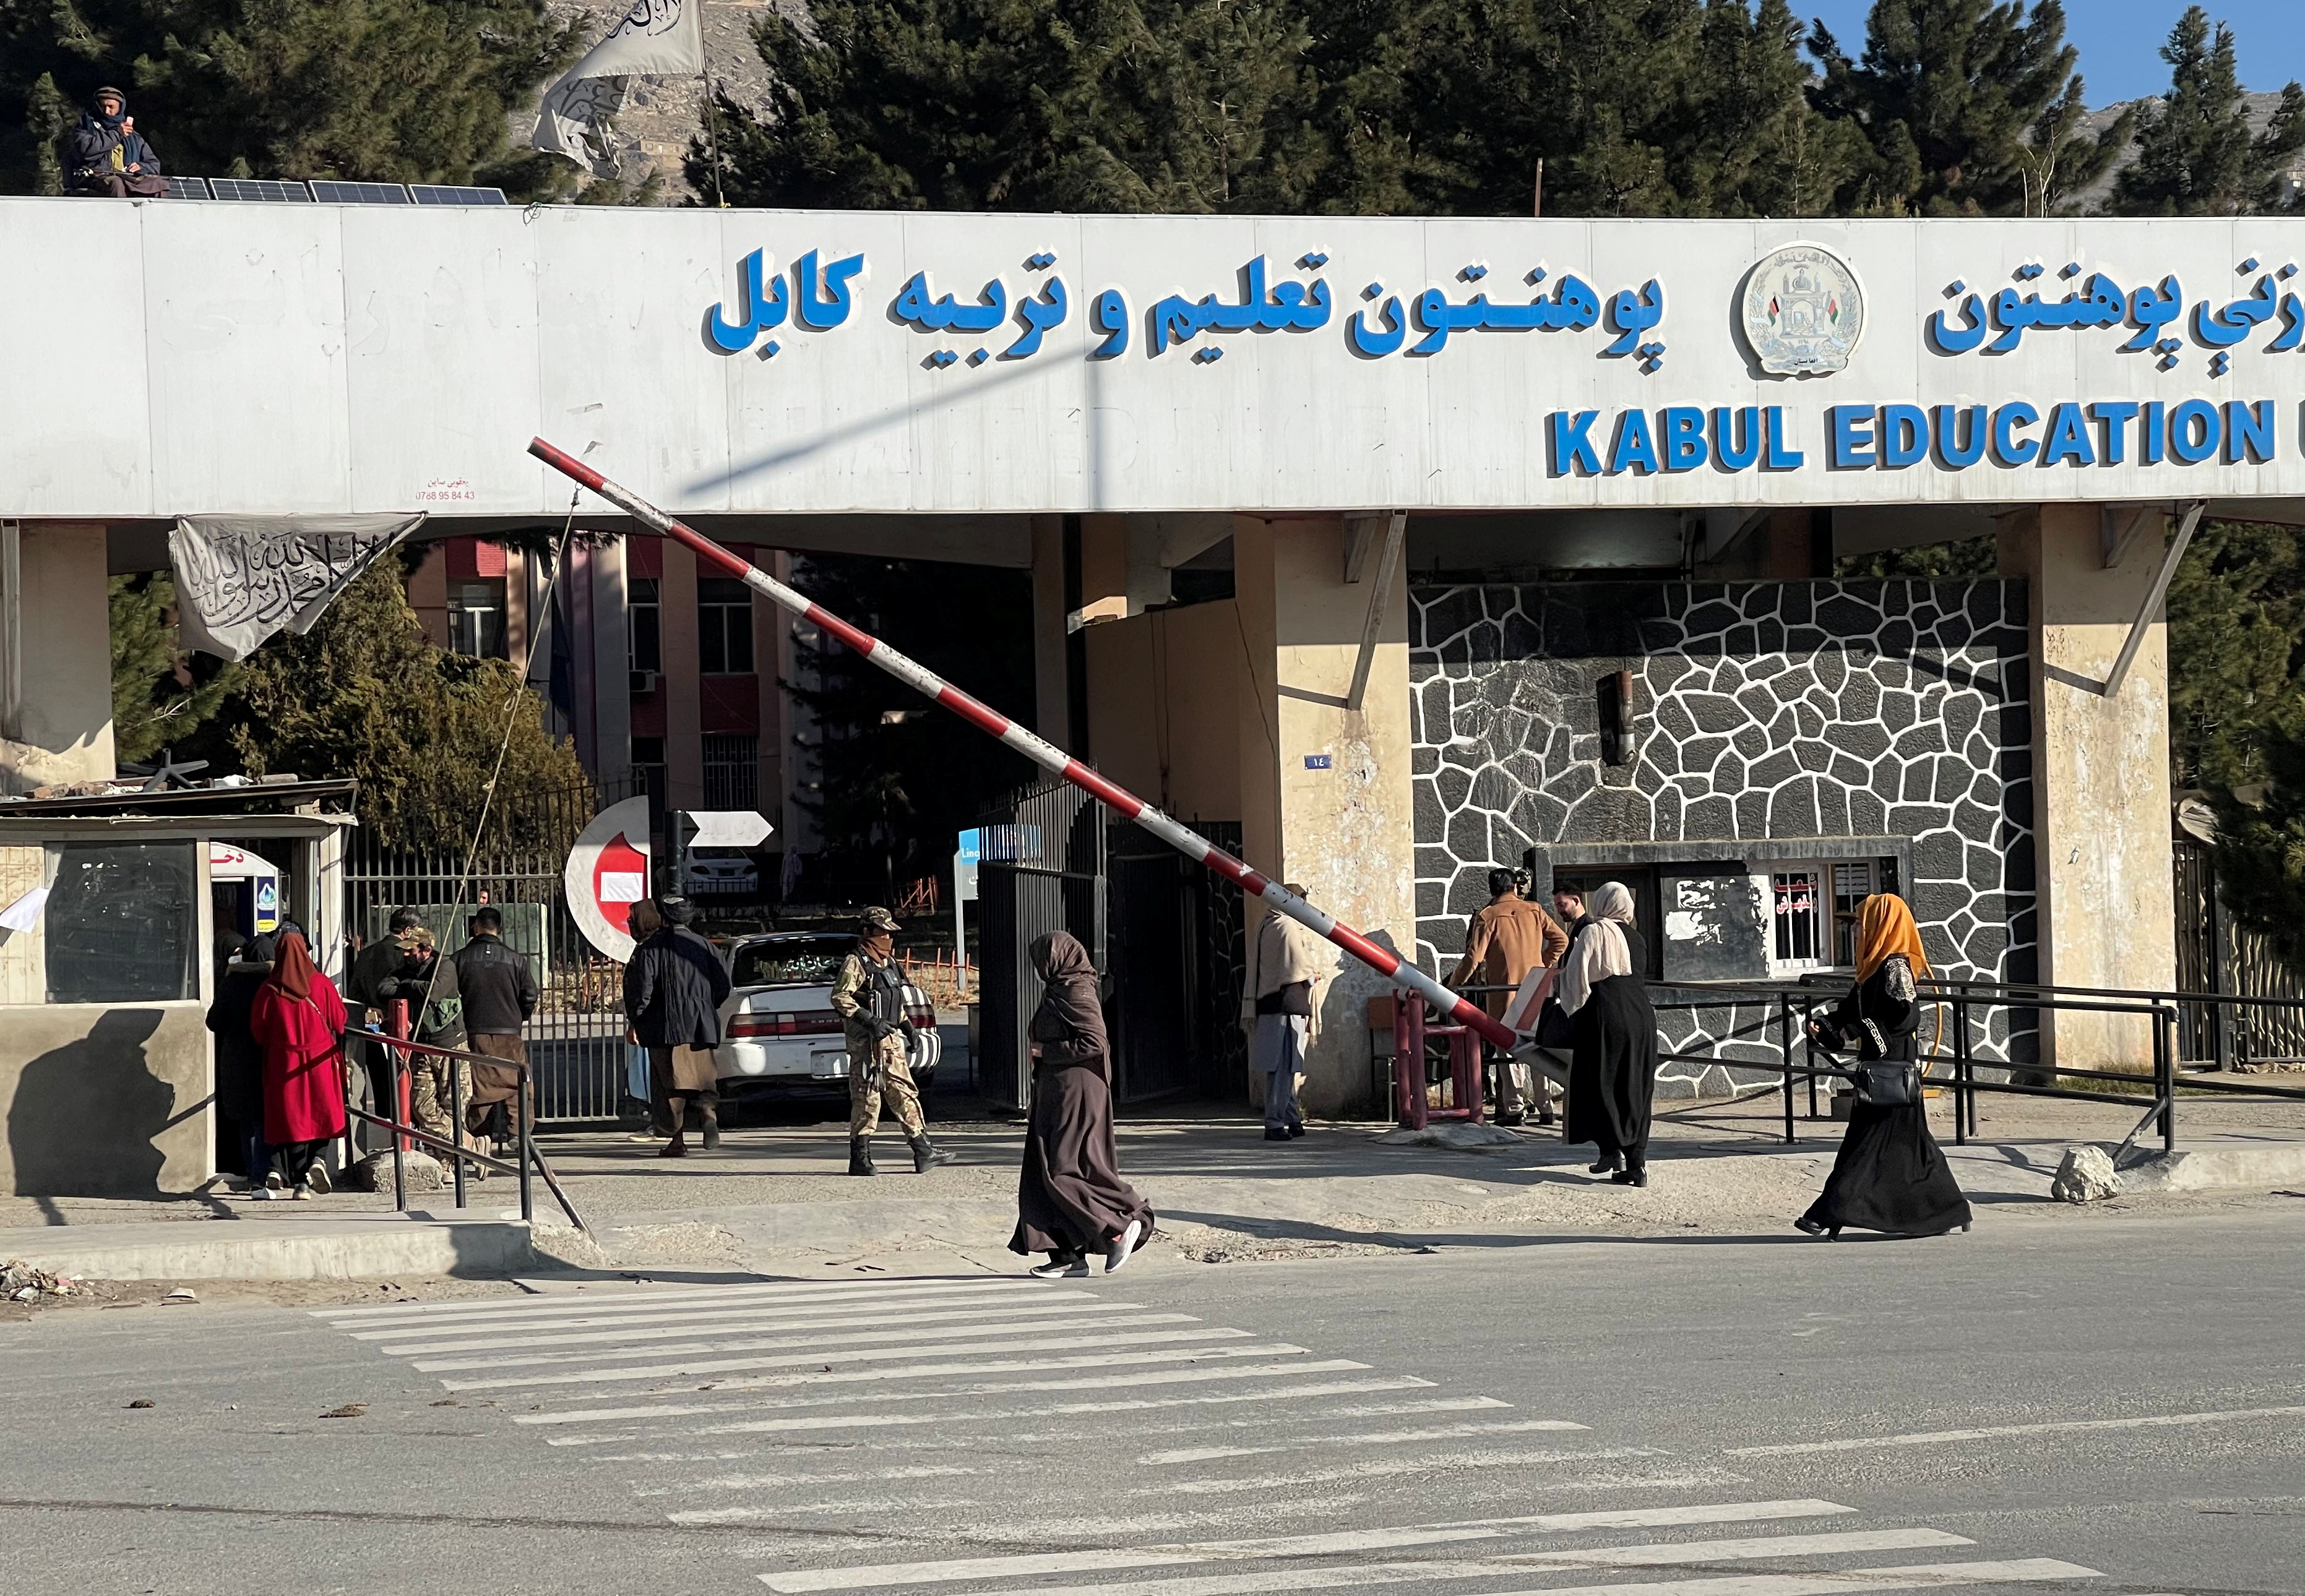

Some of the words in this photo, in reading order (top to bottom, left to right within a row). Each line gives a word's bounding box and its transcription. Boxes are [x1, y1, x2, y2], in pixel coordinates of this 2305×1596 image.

[709, 247, 864, 357] کابل
[894, 253, 1067, 364] تربیه
[1095, 289, 1129, 357] و
[1153, 252, 1332, 360] تعلیم
[1353, 265, 1665, 371] پوهنتون
[1932, 262, 2183, 370] پوهنتون
[1552, 405, 1804, 475] KABUL
[1832, 399, 2275, 468] EDUCATION
[439, 491, 449, 500] 95
[452, 491, 462, 500] 84
[464, 491, 475, 500] 43
[1314, 757, 1325, 767] ١٤
